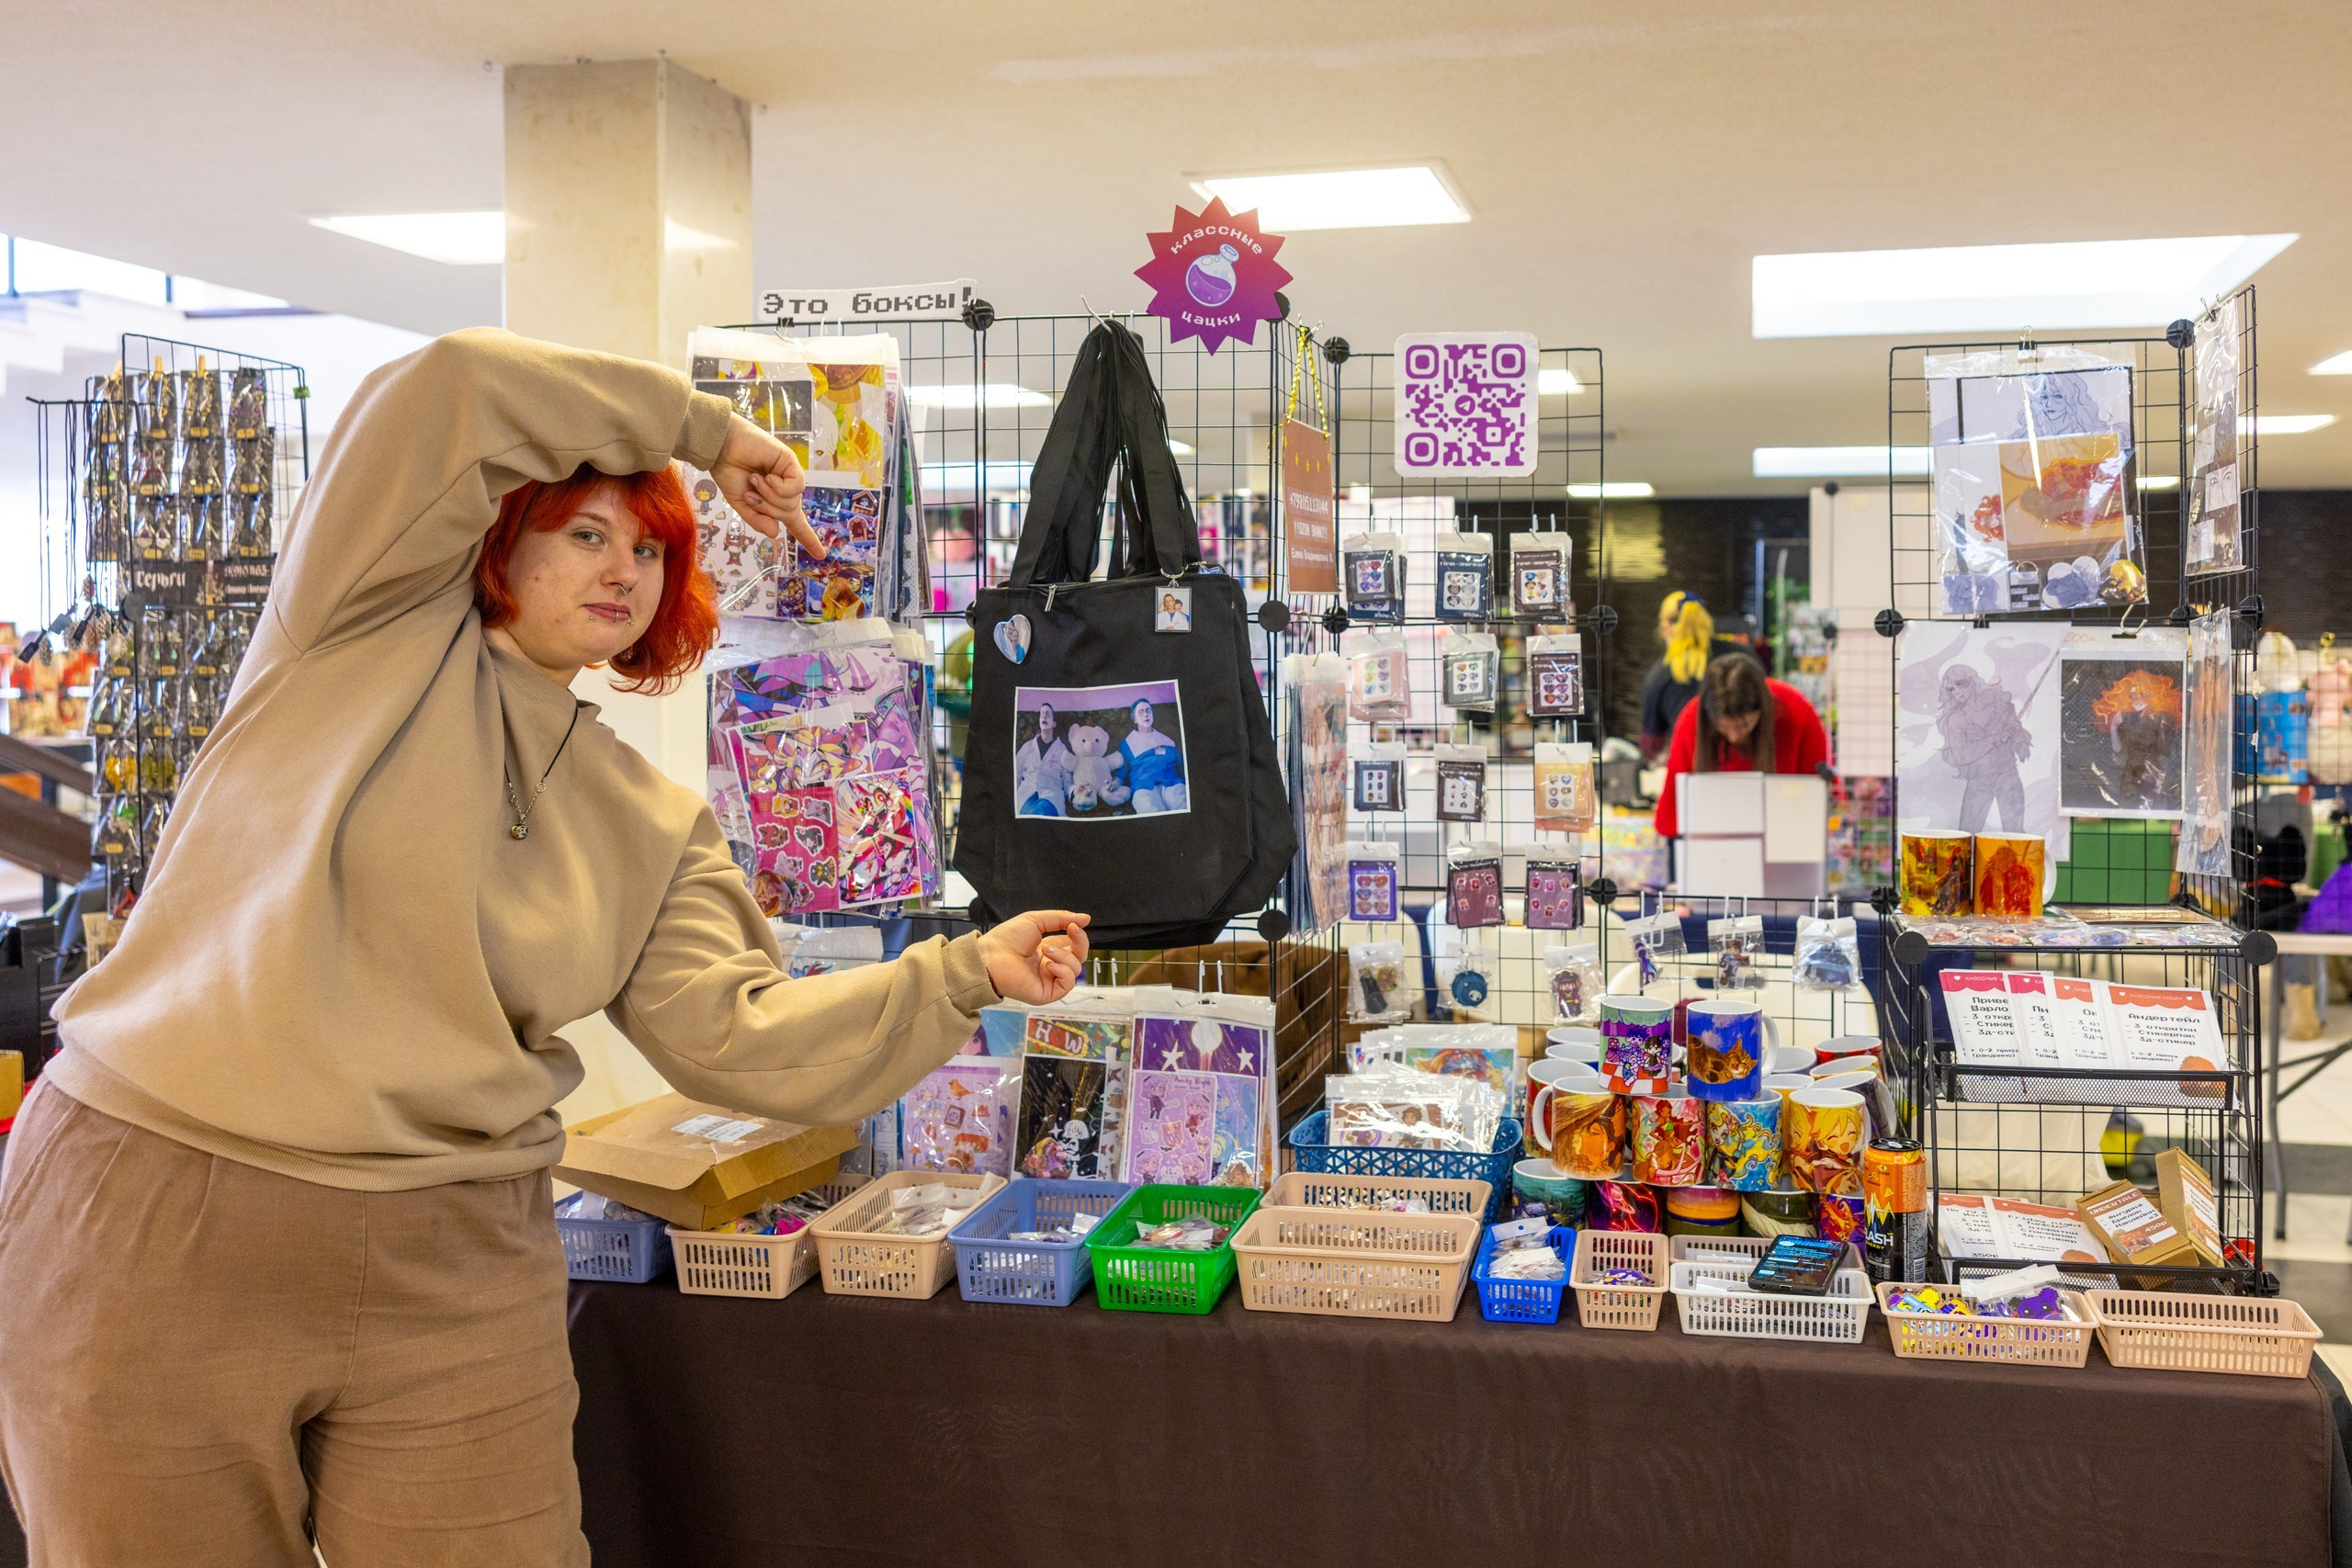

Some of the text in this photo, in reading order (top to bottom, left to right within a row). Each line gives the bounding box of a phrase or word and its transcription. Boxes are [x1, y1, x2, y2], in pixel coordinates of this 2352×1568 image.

[1170, 226, 1262, 255] классные
[763, 287, 971, 314] Это боксы!
[1182, 310, 1240, 327] цацки
[2129, 1013, 2199, 1023] Андертейл
[2139, 1030, 2195, 1038] Стикерпак
[2089, 1191, 2140, 1215] UNDERTALE
